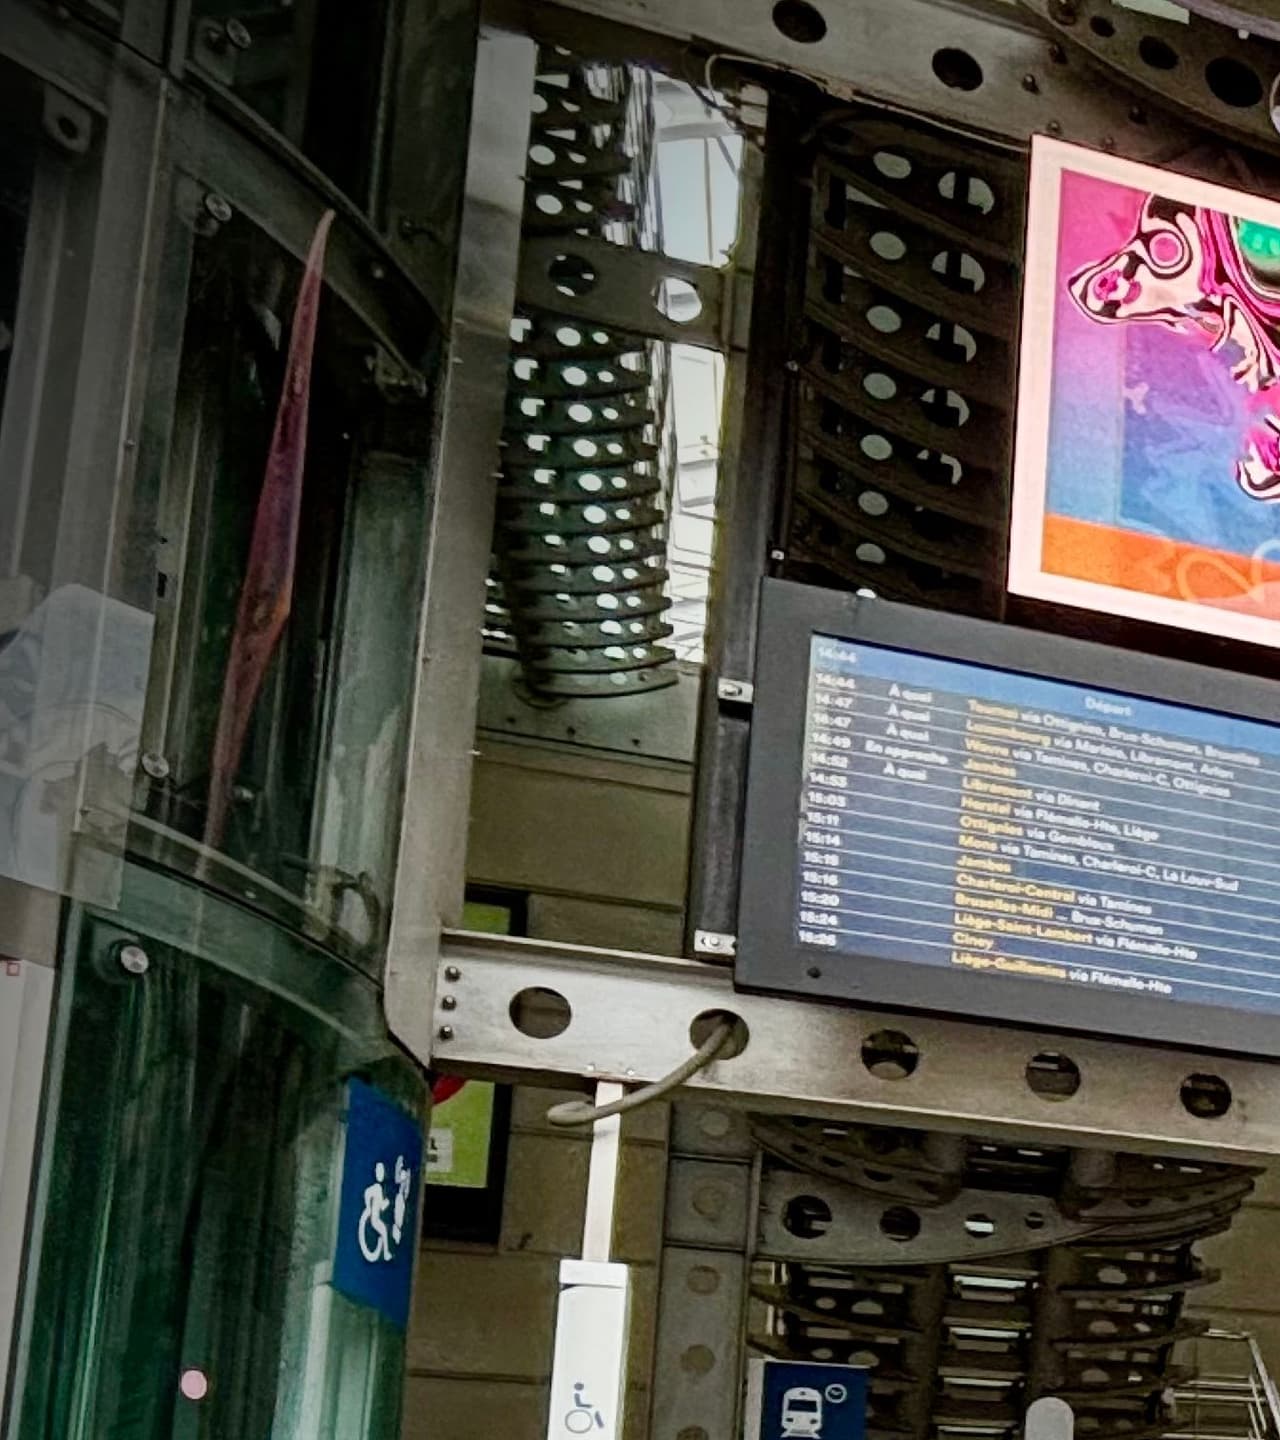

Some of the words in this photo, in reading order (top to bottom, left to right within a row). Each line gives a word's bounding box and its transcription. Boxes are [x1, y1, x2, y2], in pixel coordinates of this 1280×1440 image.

[1020, 710, 1041, 724] via
[1053, 735, 1073, 750] via
[1011, 747, 1032, 761] via
[1034, 789, 1054, 804] via
[1012, 805, 1033, 819] via
[1026, 826, 1046, 841] via
[999, 841, 1020, 856] via
[1077, 893, 1096, 907] via
[1094, 934, 1115, 948] via
[1068, 968, 1088, 982] via
